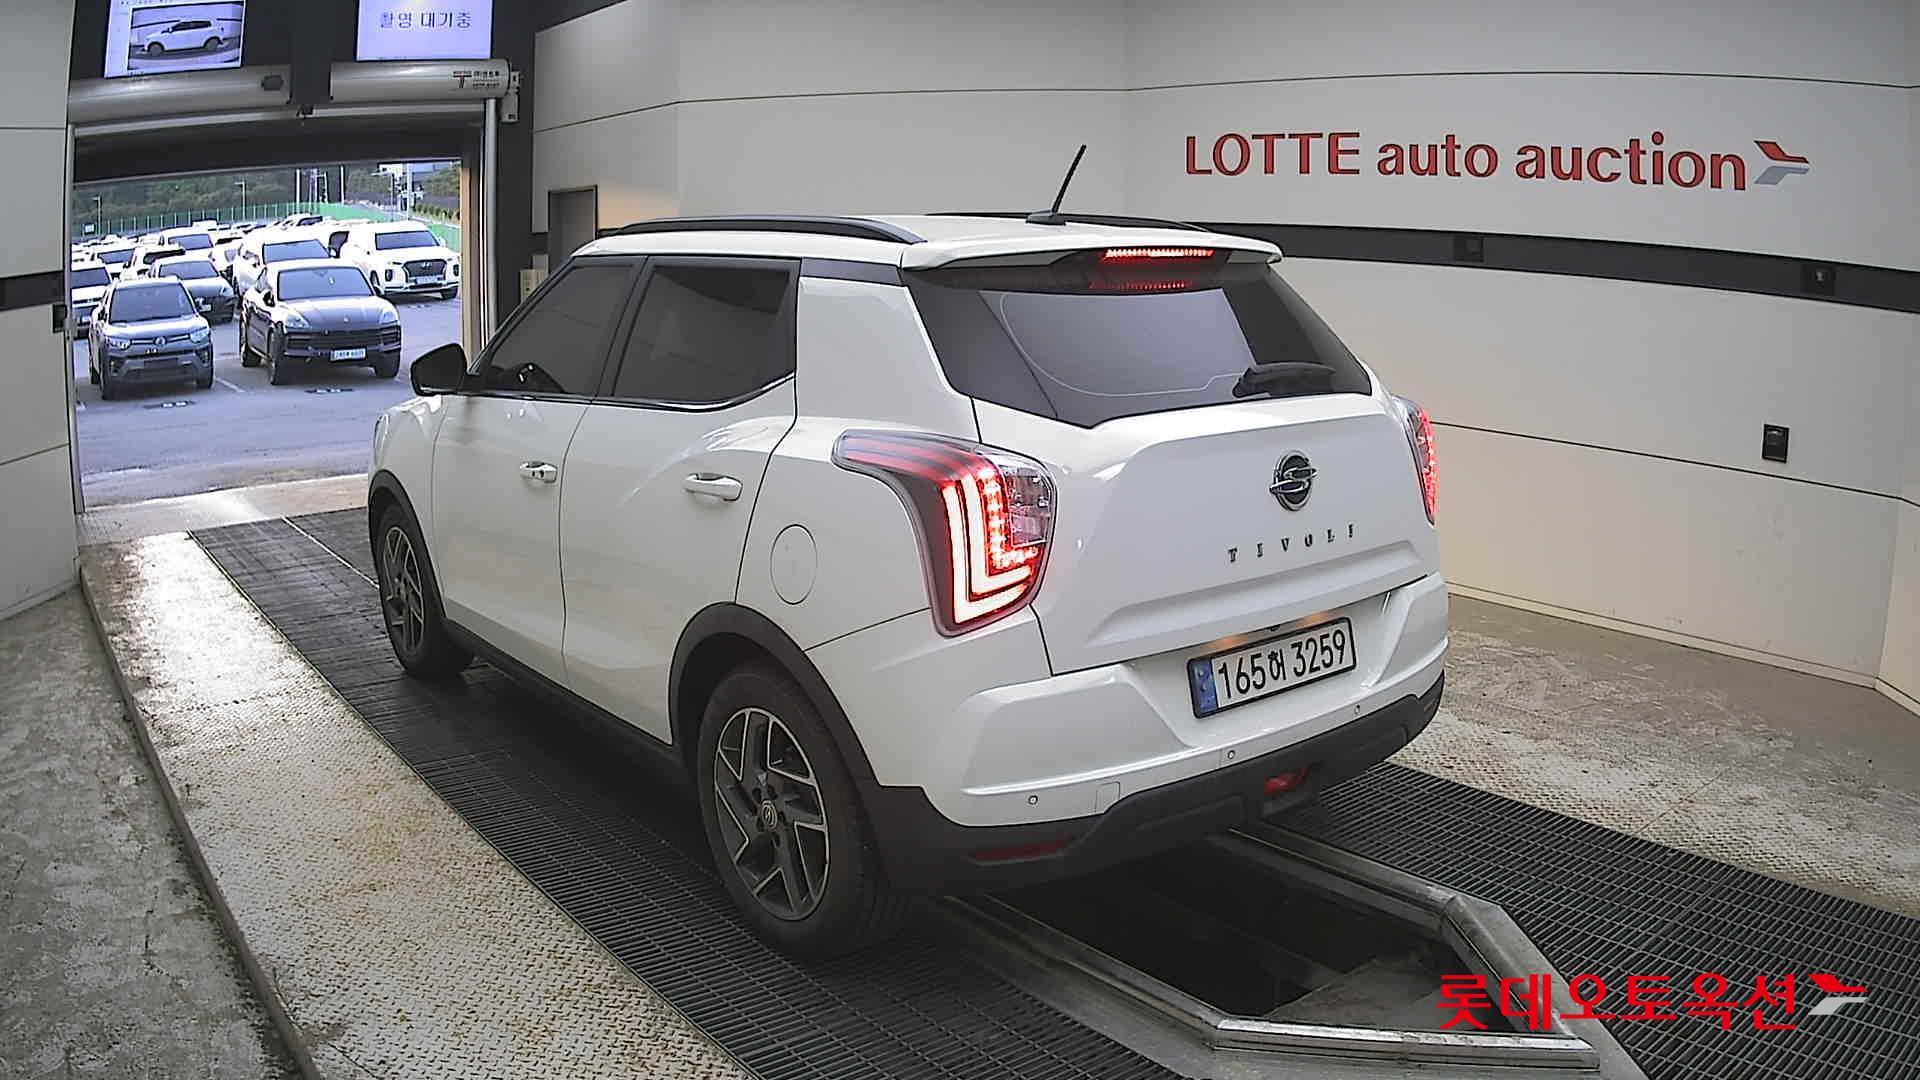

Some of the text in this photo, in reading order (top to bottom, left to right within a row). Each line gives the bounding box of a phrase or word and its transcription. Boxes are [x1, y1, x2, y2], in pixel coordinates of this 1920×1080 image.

[420, 11, 471, 29] 대기중
[1185, 131, 1746, 191] LOTTE auto auction
[1227, 523, 1354, 564] TIVOLI
[1218, 629, 1346, 699] 165허 3259
